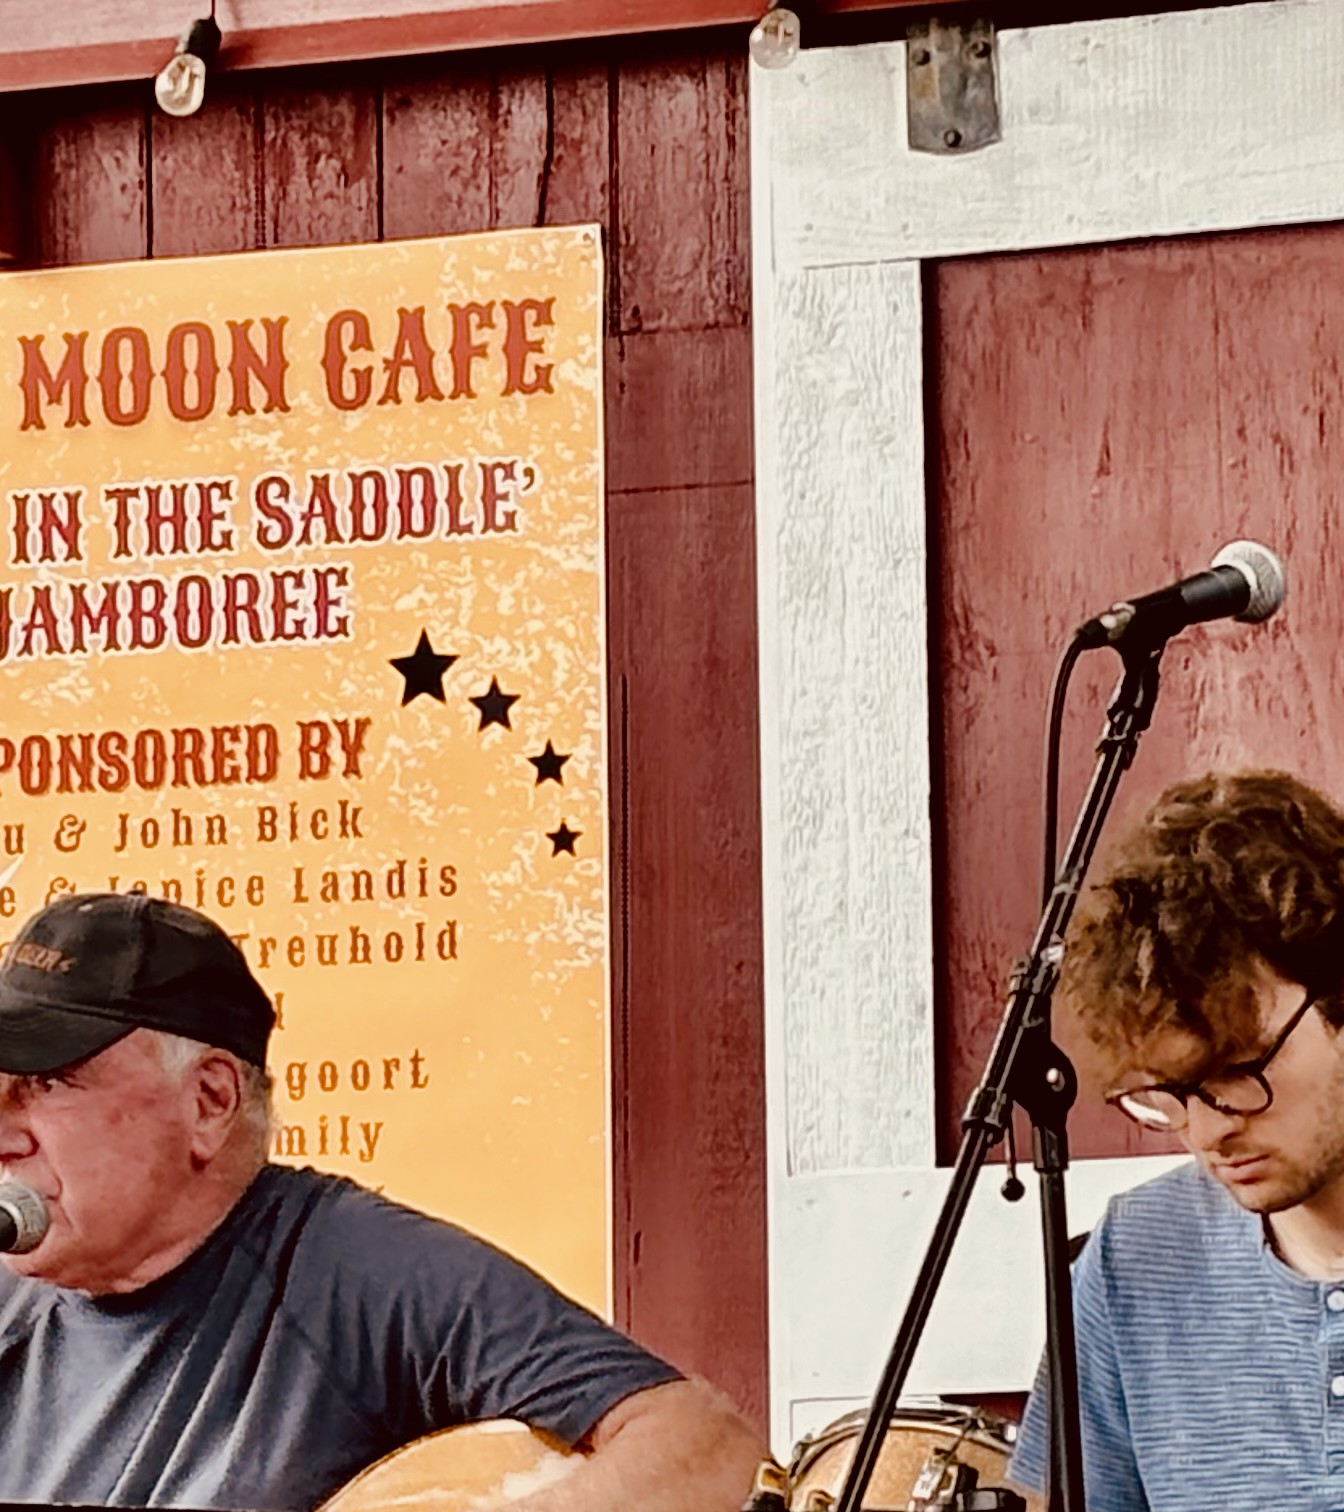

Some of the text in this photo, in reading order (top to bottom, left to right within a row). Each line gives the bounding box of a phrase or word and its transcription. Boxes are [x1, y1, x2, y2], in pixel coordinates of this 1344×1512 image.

[17, 315, 292, 433] MOON
[320, 296, 557, 412] CAFE
[11, 489, 84, 565] IN
[103, 478, 235, 560] THE
[295, 716, 373, 782] BY
[53, 813, 87, 853] &
[114, 807, 228, 853] John
[256, 799, 364, 843] Bick
[292, 856, 459, 904] Landis
[285, 1048, 430, 1101] goort
[274, 1115, 384, 1163] mily
